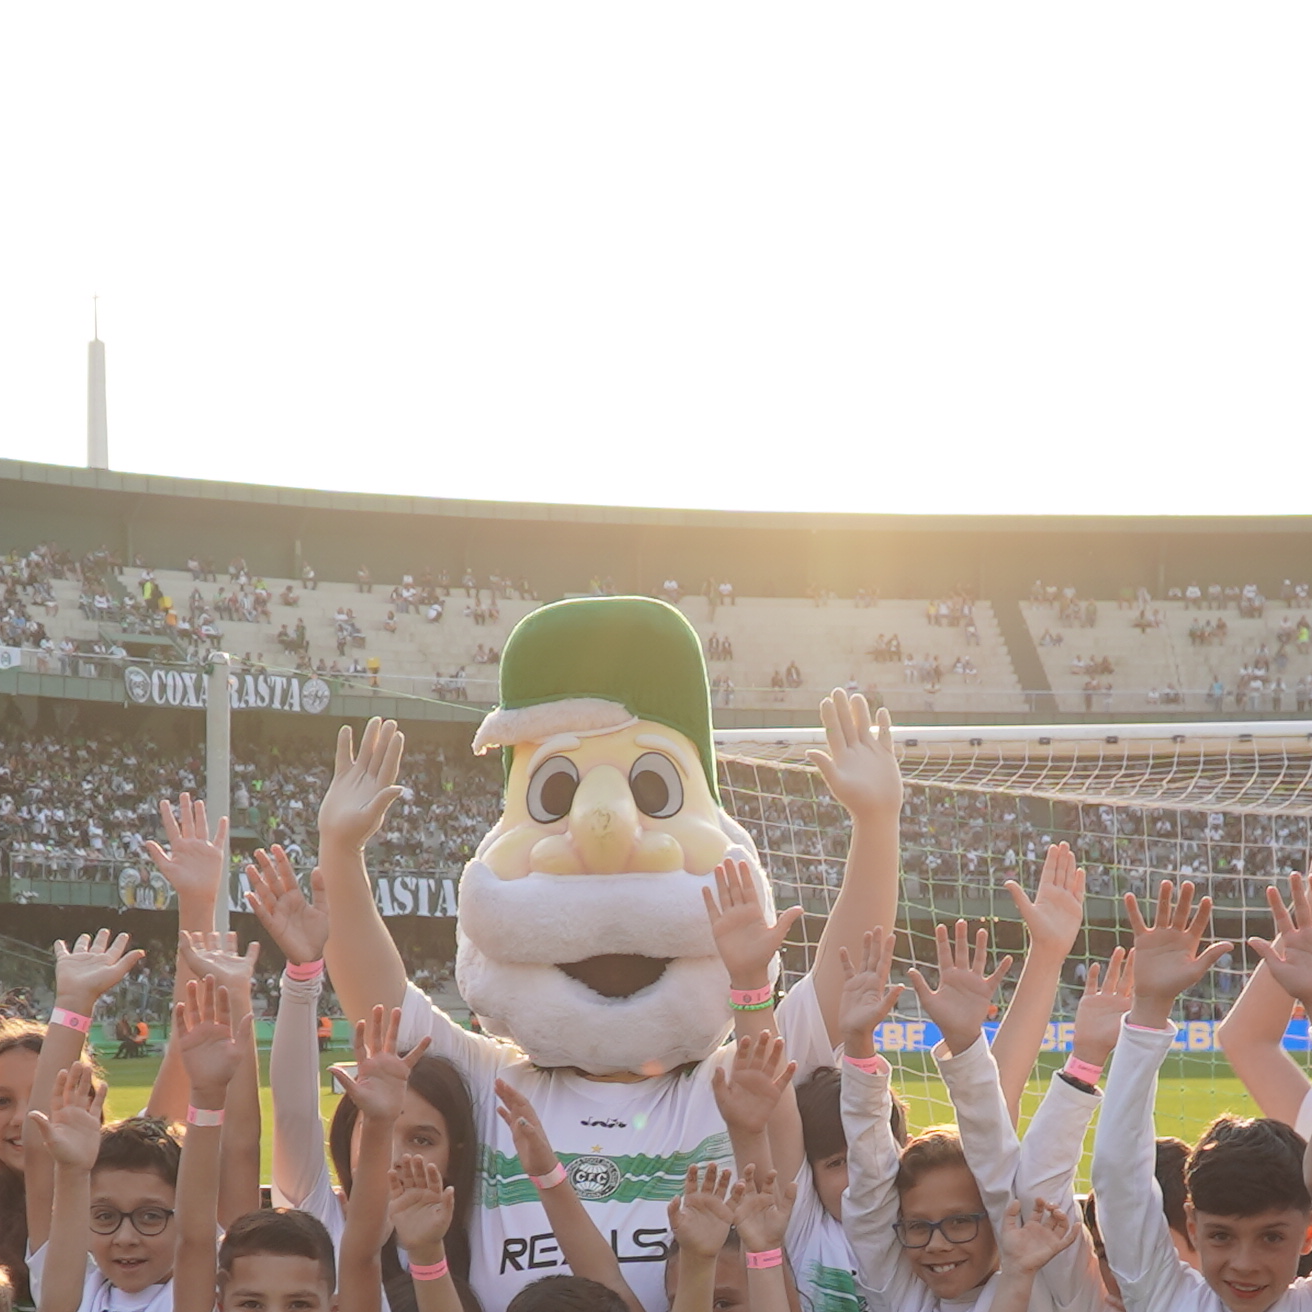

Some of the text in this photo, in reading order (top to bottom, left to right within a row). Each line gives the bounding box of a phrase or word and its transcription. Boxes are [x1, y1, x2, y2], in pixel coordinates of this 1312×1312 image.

[375, 876, 456, 917] ASTA
[1040, 1023, 1076, 1050] BF
[576, 1171, 607, 1184] CFC
